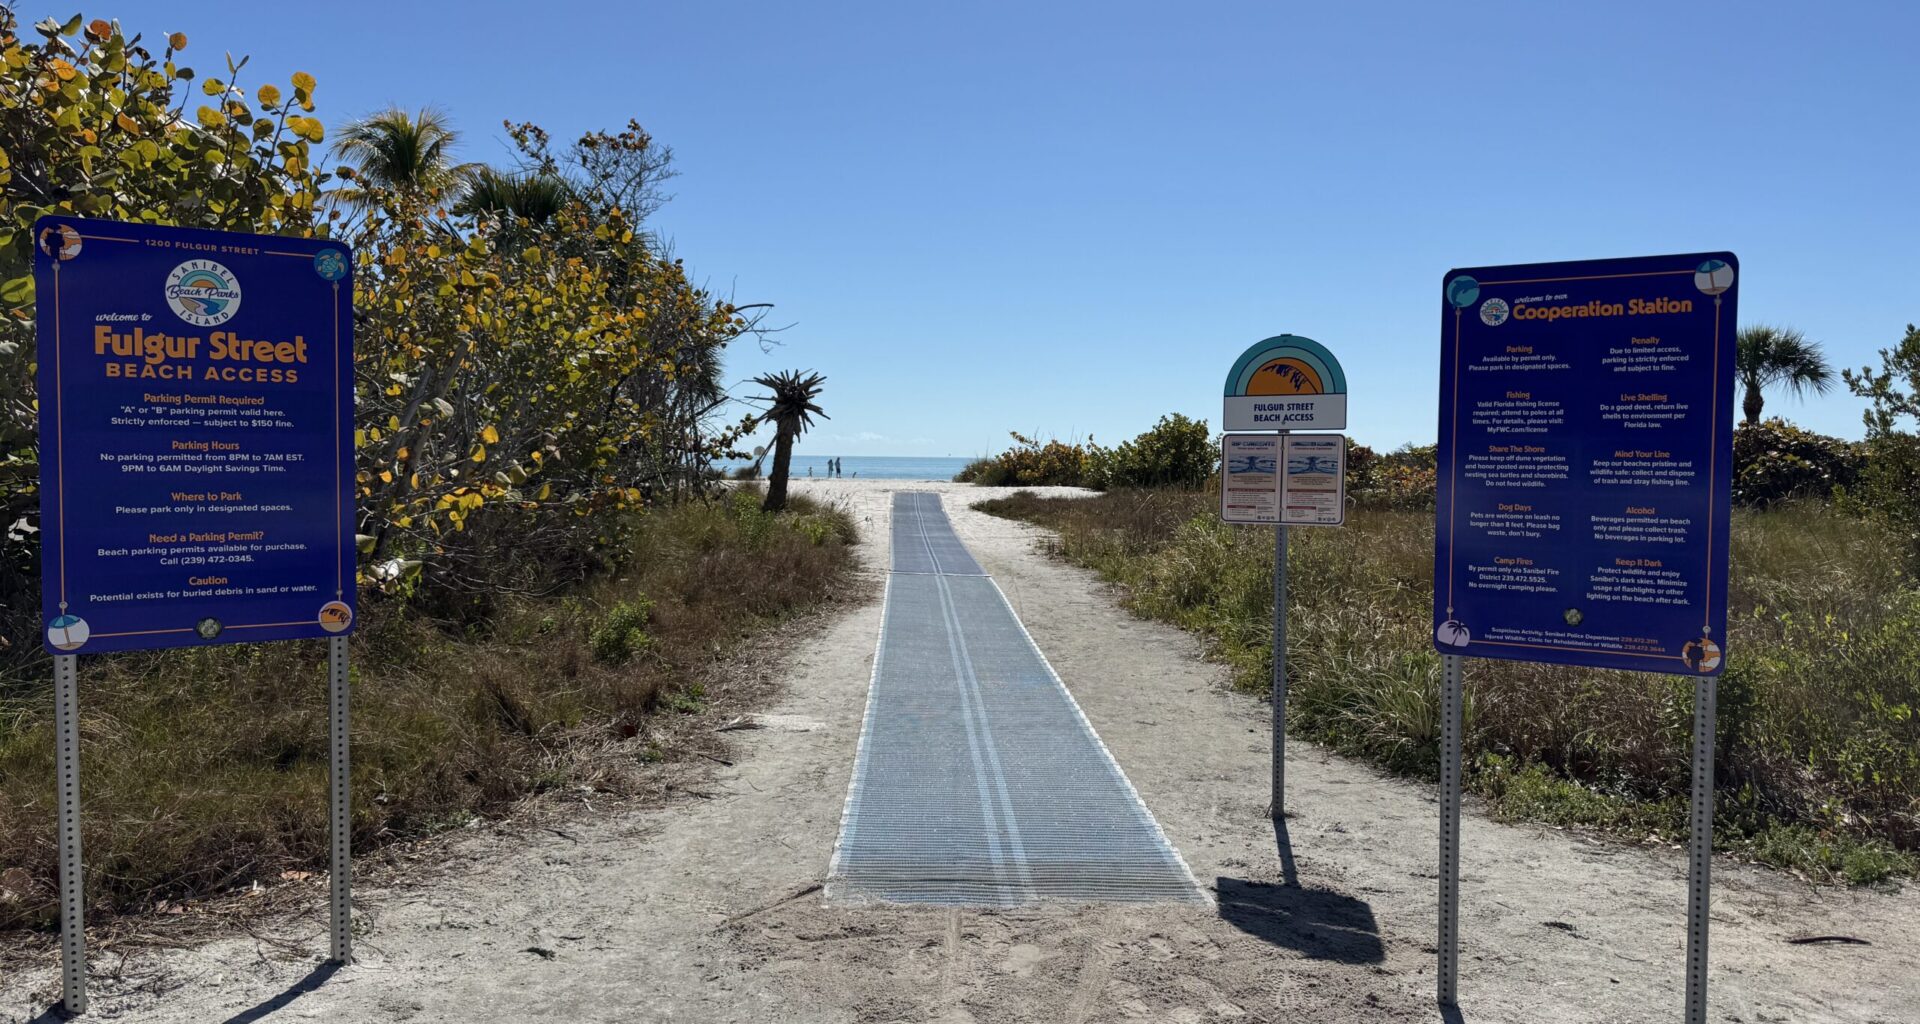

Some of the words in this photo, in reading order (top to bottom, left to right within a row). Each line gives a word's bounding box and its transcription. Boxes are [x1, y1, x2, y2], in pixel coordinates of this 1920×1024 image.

[145, 239, 171, 247] 1200
[175, 242, 217, 252] FULGUR
[221, 246, 259, 255] STREET
[172, 261, 234, 284] SANIBEL
[166, 284, 202, 300] Beach
[205, 287, 238, 300] Parks
[1513, 300, 1624, 322] Cooperation
[1628, 297, 1692, 315] Station
[96, 312, 139, 321] welcome
[141, 313, 152, 321] to
[180, 309, 229, 325] ISLAND
[95, 325, 200, 363] Fulgur
[209, 331, 307, 363] Street
[1631, 336, 1660, 345] Penalty
[1506, 346, 1533, 354] Parking
[1541, 354, 1556, 362] only.
[1512, 363, 1546, 371] designated
[106, 362, 192, 379] BEACH
[204, 367, 298, 383] ACCESS
[144, 393, 181, 405] Parking
[184, 394, 216, 404] Permit
[219, 395, 264, 406] Required
[1506, 391, 1530, 400] Fishing
[1637, 393, 1667, 403] Shelling
[151, 406, 167, 414] "B"
[170, 407, 205, 416] parking
[208, 408, 237, 416] permit
[1254, 403, 1284, 412] FULGUR
[1287, 402, 1314, 411] STREET
[1616, 404, 1633, 412] good
[111, 417, 146, 426] Strictly
[148, 418, 190, 426] enforced
[204, 419, 237, 428] subject
[251, 419, 273, 427] $150
[1254, 414, 1280, 422] BEACH
[1283, 413, 1314, 422] ACCESS
[1487, 426, 1548, 434] MyFWC.com/license
[172, 441, 209, 452] Parking
[212, 441, 240, 450] Hours
[1524, 445, 1545, 453] Shore
[100, 453, 115, 461] No
[117, 453, 154, 462] parking
[157, 453, 202, 462] permitted
[1614, 450, 1634, 458] Mind
[1635, 450, 1653, 458] Your
[1654, 450, 1670, 458] Line
[184, 465, 222, 473] Daylight
[225, 465, 260, 473] Savings
[1652, 460, 1678, 468] pristine
[171, 492, 205, 501] Where
[207, 492, 218, 501] to
[220, 492, 242, 501] Park
[116, 506, 147, 514] Please
[150, 506, 171, 514] park
[174, 505, 194, 514] only
[208, 504, 258, 513] designated
[1498, 503, 1513, 512] Dog
[1514, 504, 1532, 512] Days
[1626, 506, 1655, 514] Alcohol
[1591, 516, 1625, 524] Beverages
[149, 533, 177, 543] Need
[189, 532, 225, 543] Parking
[228, 531, 264, 540] Permit?
[98, 548, 128, 556] Beach
[131, 547, 167, 556] parking
[170, 546, 205, 555] permits
[208, 544, 248, 552] available
[265, 543, 307, 552] purchase.
[181, 556, 205, 565] (239)
[208, 555, 254, 563] 472-0345.
[1494, 556, 1516, 566] Camp
[1615, 558, 1636, 567] Keep
[1644, 559, 1662, 567] Dark
[189, 576, 228, 586] Caution
[90, 592, 134, 602] Potential
[136, 592, 164, 600] exists
[183, 589, 212, 597] buried
[215, 588, 243, 596] debris
[256, 586, 278, 594] sand
